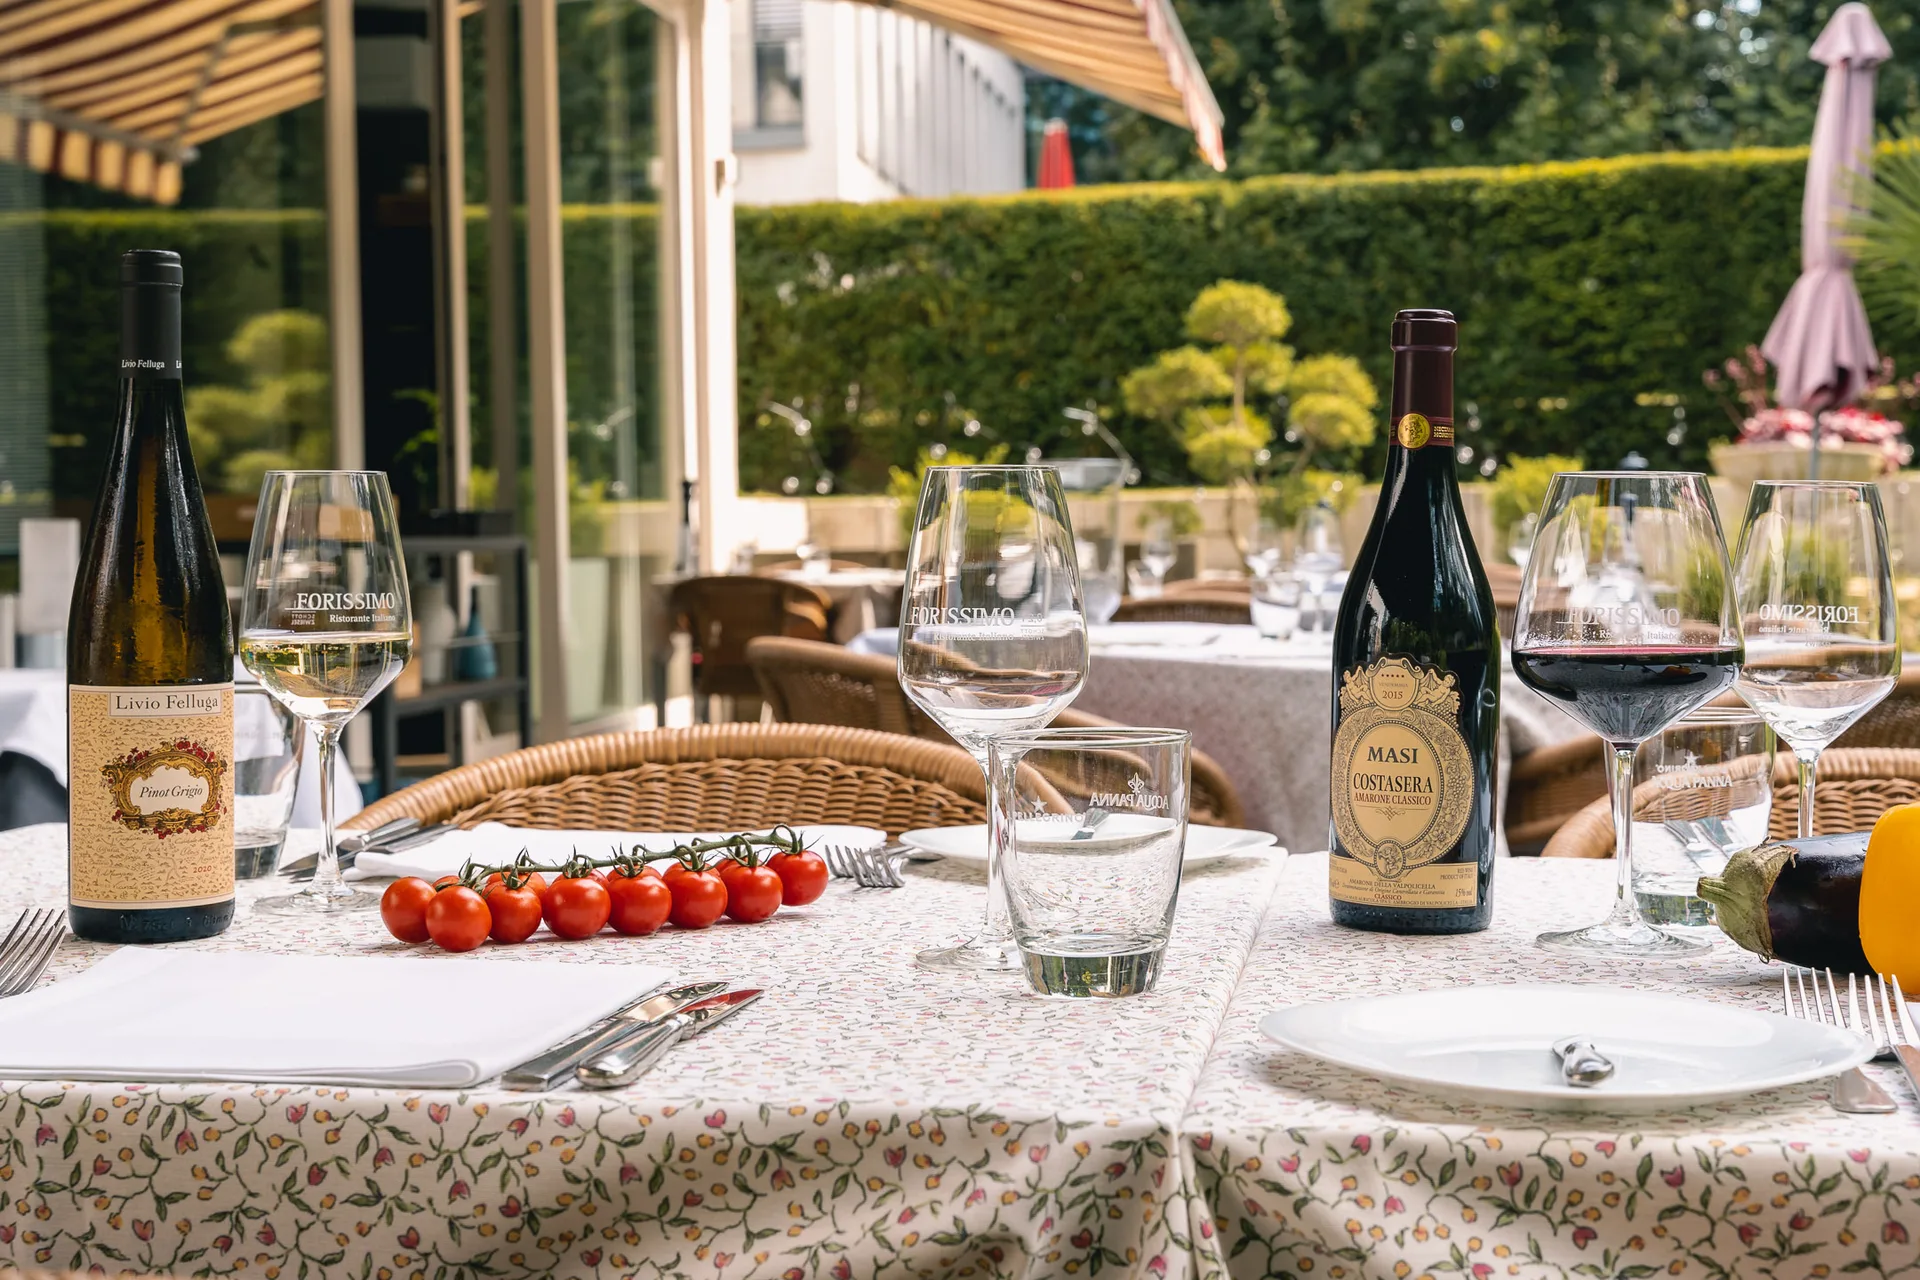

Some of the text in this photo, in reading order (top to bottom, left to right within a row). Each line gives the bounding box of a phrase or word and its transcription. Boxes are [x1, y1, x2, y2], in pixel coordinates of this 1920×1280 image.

[121, 359, 136, 368] Livio
[137, 359, 165, 370] Felluga
[296, 592, 396, 610] FORISSIMO
[329, 614, 396, 623] Ristorante Italiano
[911, 606, 1015, 627] FORISSIMO
[1382, 690, 1403, 700] 2015
[115, 693, 218, 712] Livio Felluga
[1367, 746, 1419, 764] MASI
[1353, 772, 1434, 793] COSTASERA
[1693, 774, 1733, 788] PANNA
[139, 784, 203, 799] Pinot Grigio
[1354, 792, 1432, 806] AMARONE CLASSICO
[192, 865, 213, 874] 2020
